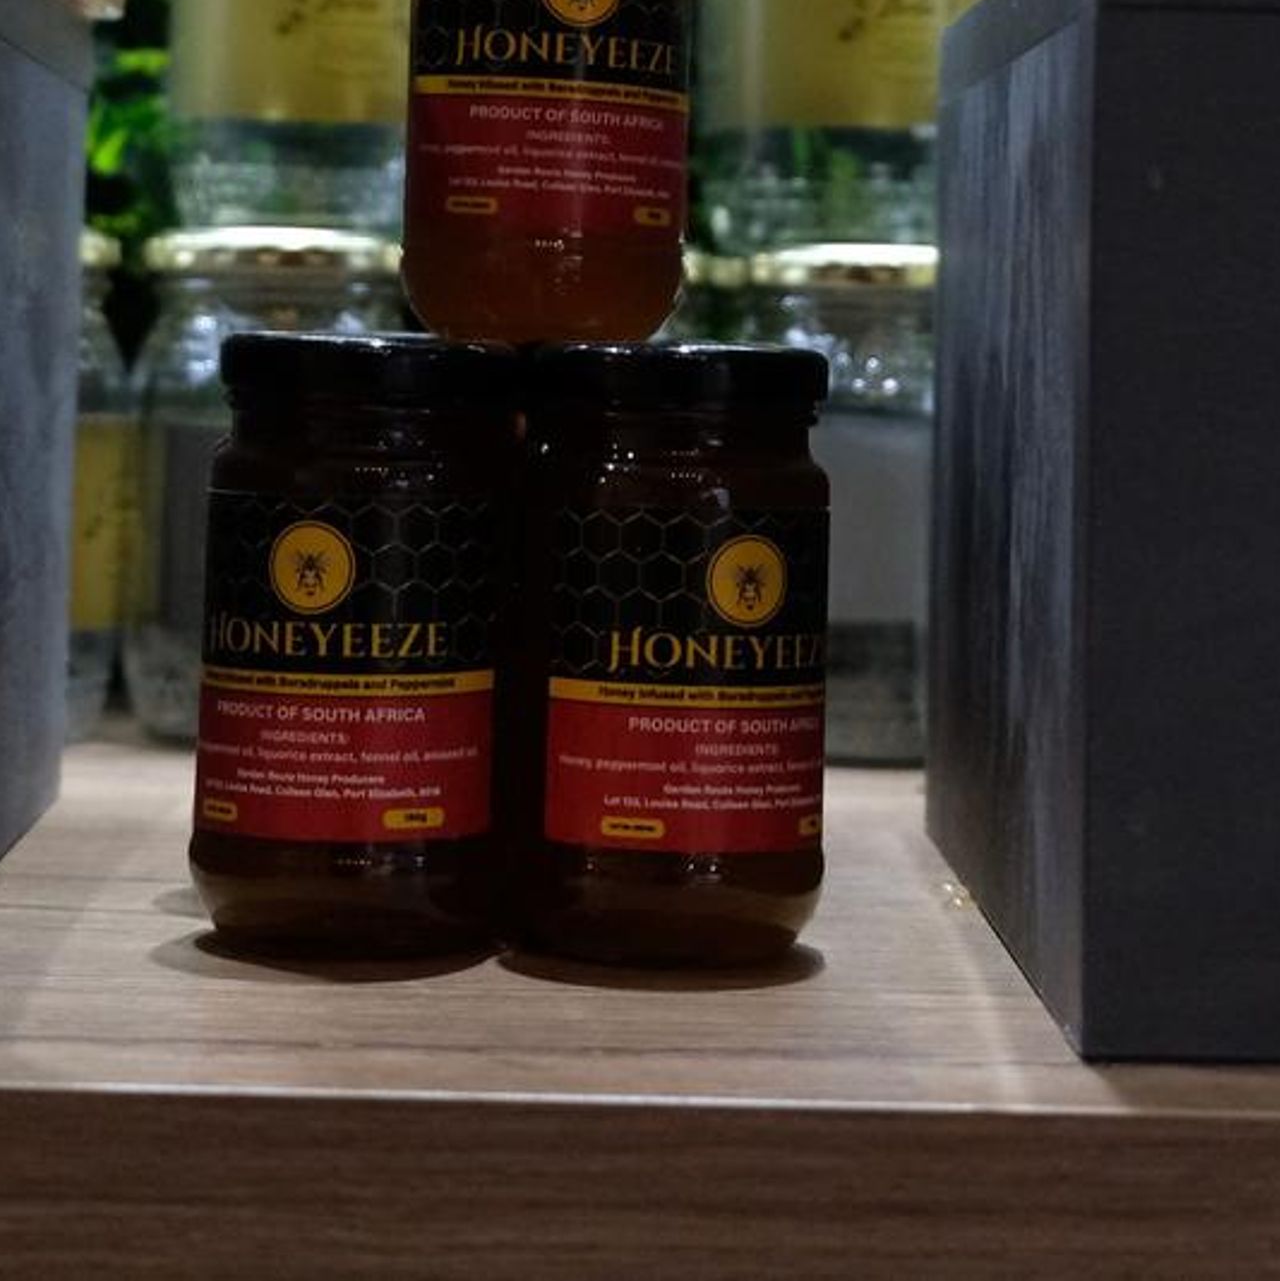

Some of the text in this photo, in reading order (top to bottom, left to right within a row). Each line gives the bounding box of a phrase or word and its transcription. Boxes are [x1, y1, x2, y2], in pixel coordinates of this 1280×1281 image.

[470, 104, 543, 121] PRODUCT
[545, 108, 569, 122] OF
[570, 108, 620, 127] SOUTH
[211, 610, 449, 659] HONEYEEZE
[608, 625, 820, 673] HONEYEEZ
[598, 685, 636, 700] Honey
[218, 699, 426, 723] PRODUCT OF SOUTH AFRICA
[628, 716, 713, 733] PRODUCT
[715, 719, 738, 733] OF
[740, 718, 788, 734] SOUTH
